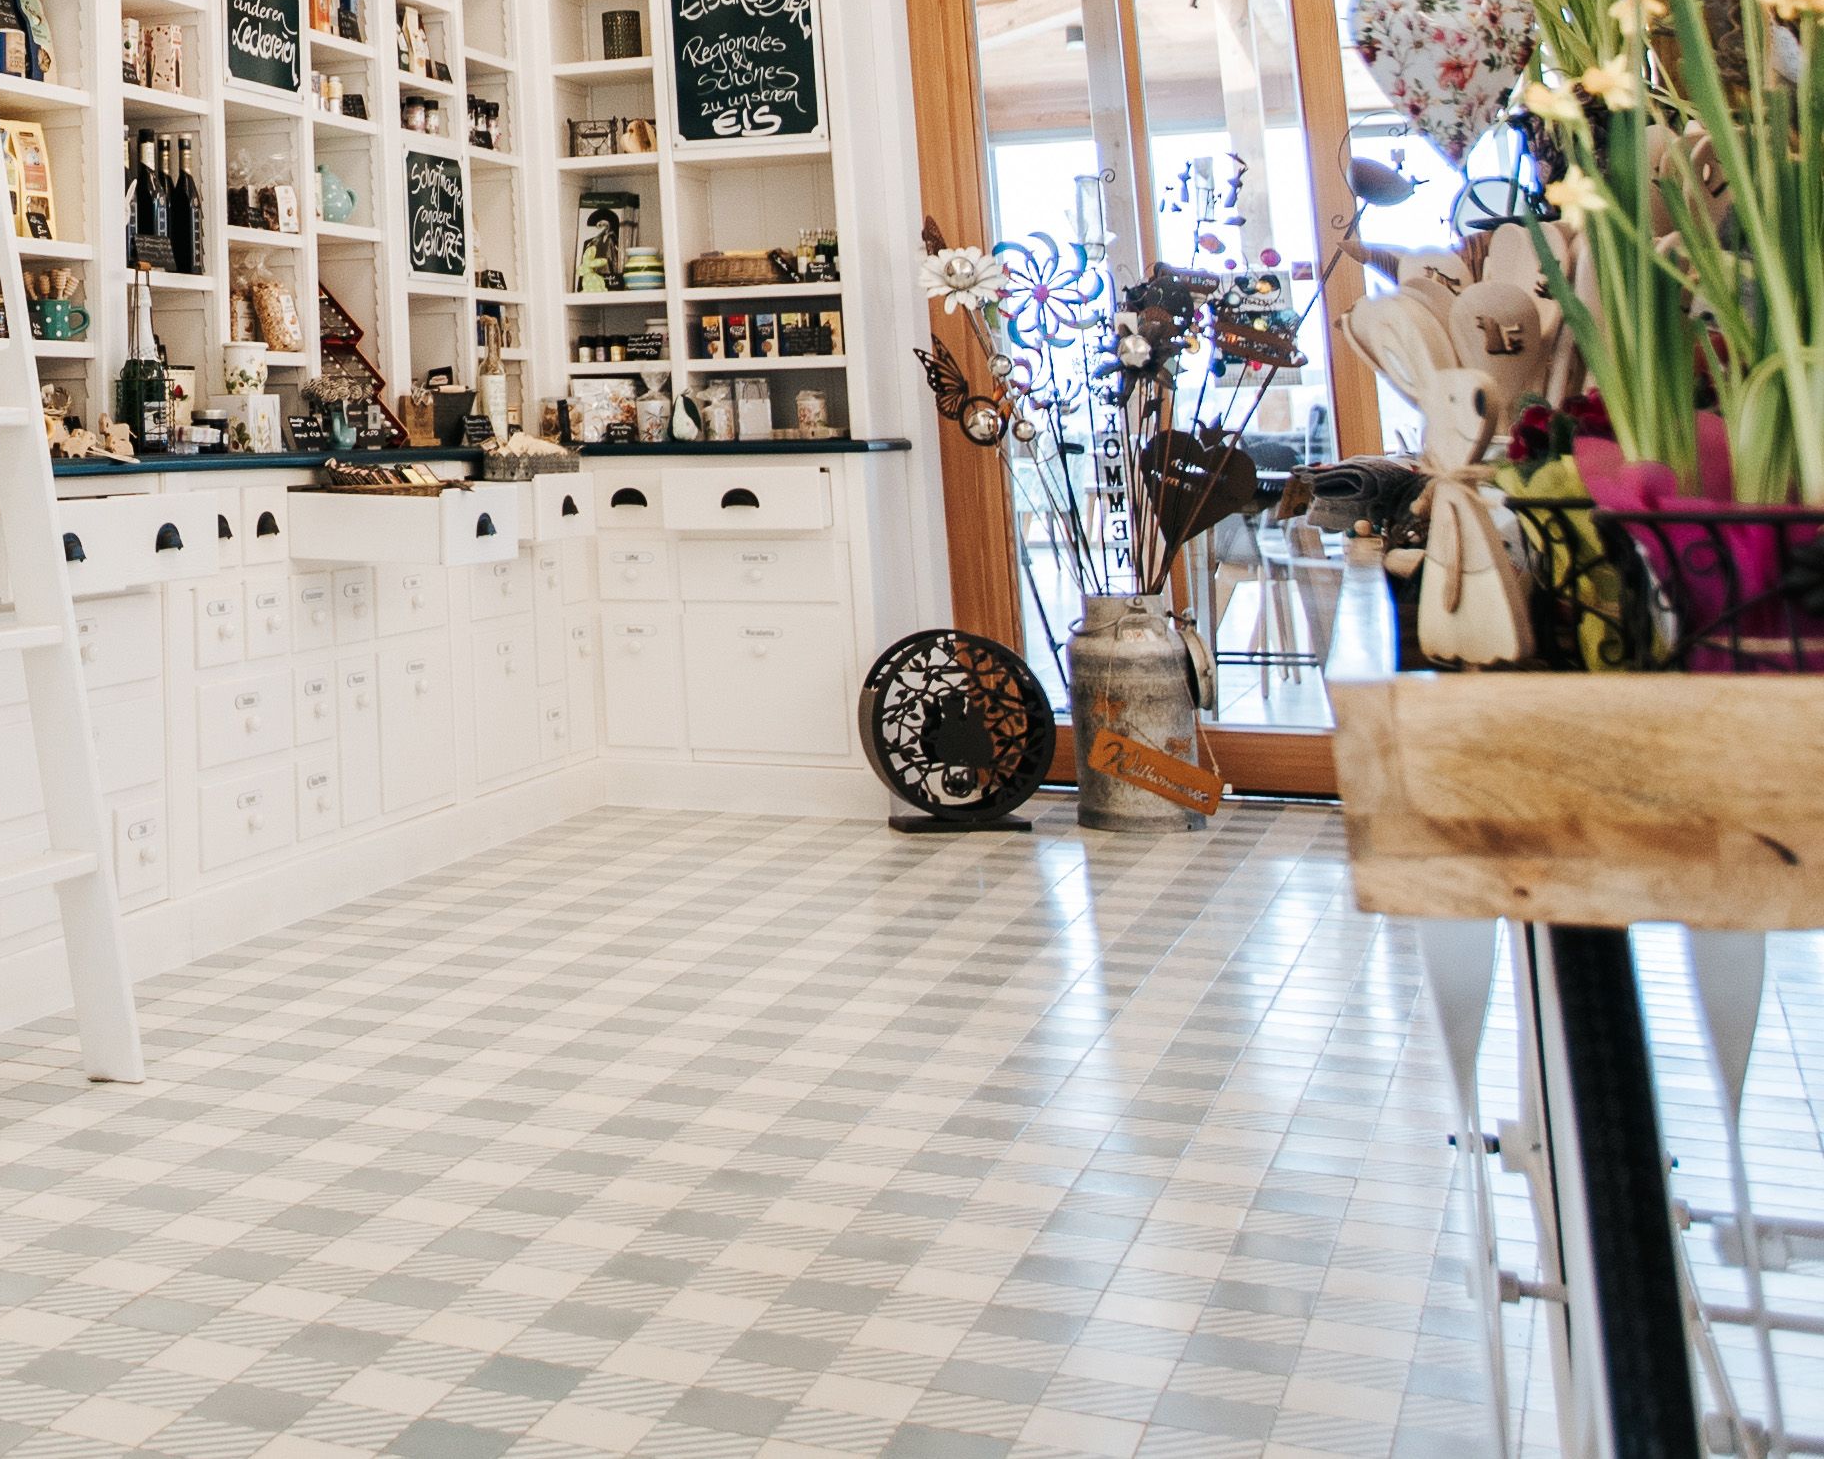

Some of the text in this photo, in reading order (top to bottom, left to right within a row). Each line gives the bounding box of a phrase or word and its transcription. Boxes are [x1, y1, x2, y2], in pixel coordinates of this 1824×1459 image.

[683, 26, 786, 73] Regionales
[697, 58, 800, 97] Schönes
[701, 88, 807, 117] zu unserem
[712, 104, 782, 138] EIS
